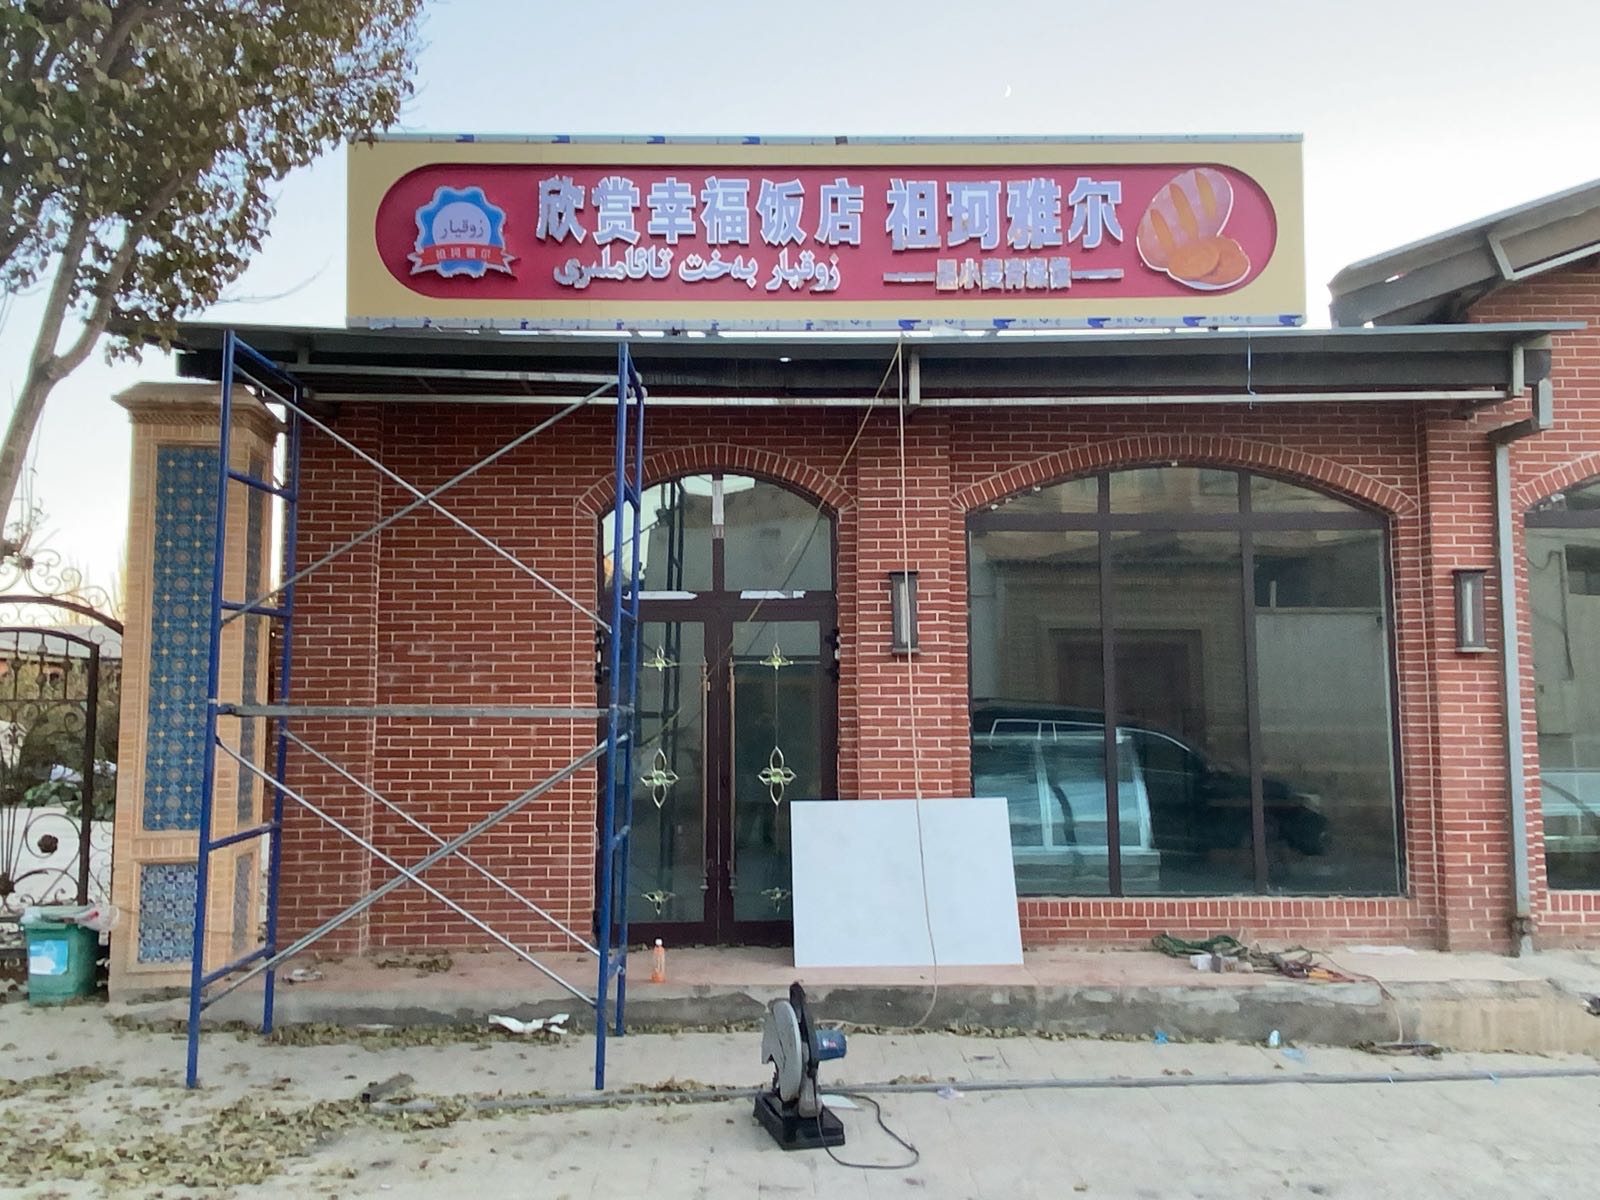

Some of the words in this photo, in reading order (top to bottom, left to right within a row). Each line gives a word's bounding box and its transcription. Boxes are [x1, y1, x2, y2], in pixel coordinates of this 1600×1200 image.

[536, 174, 865, 246] 欣赏幸福饭店
[886, 176, 1124, 250] 祖珂雅尔
